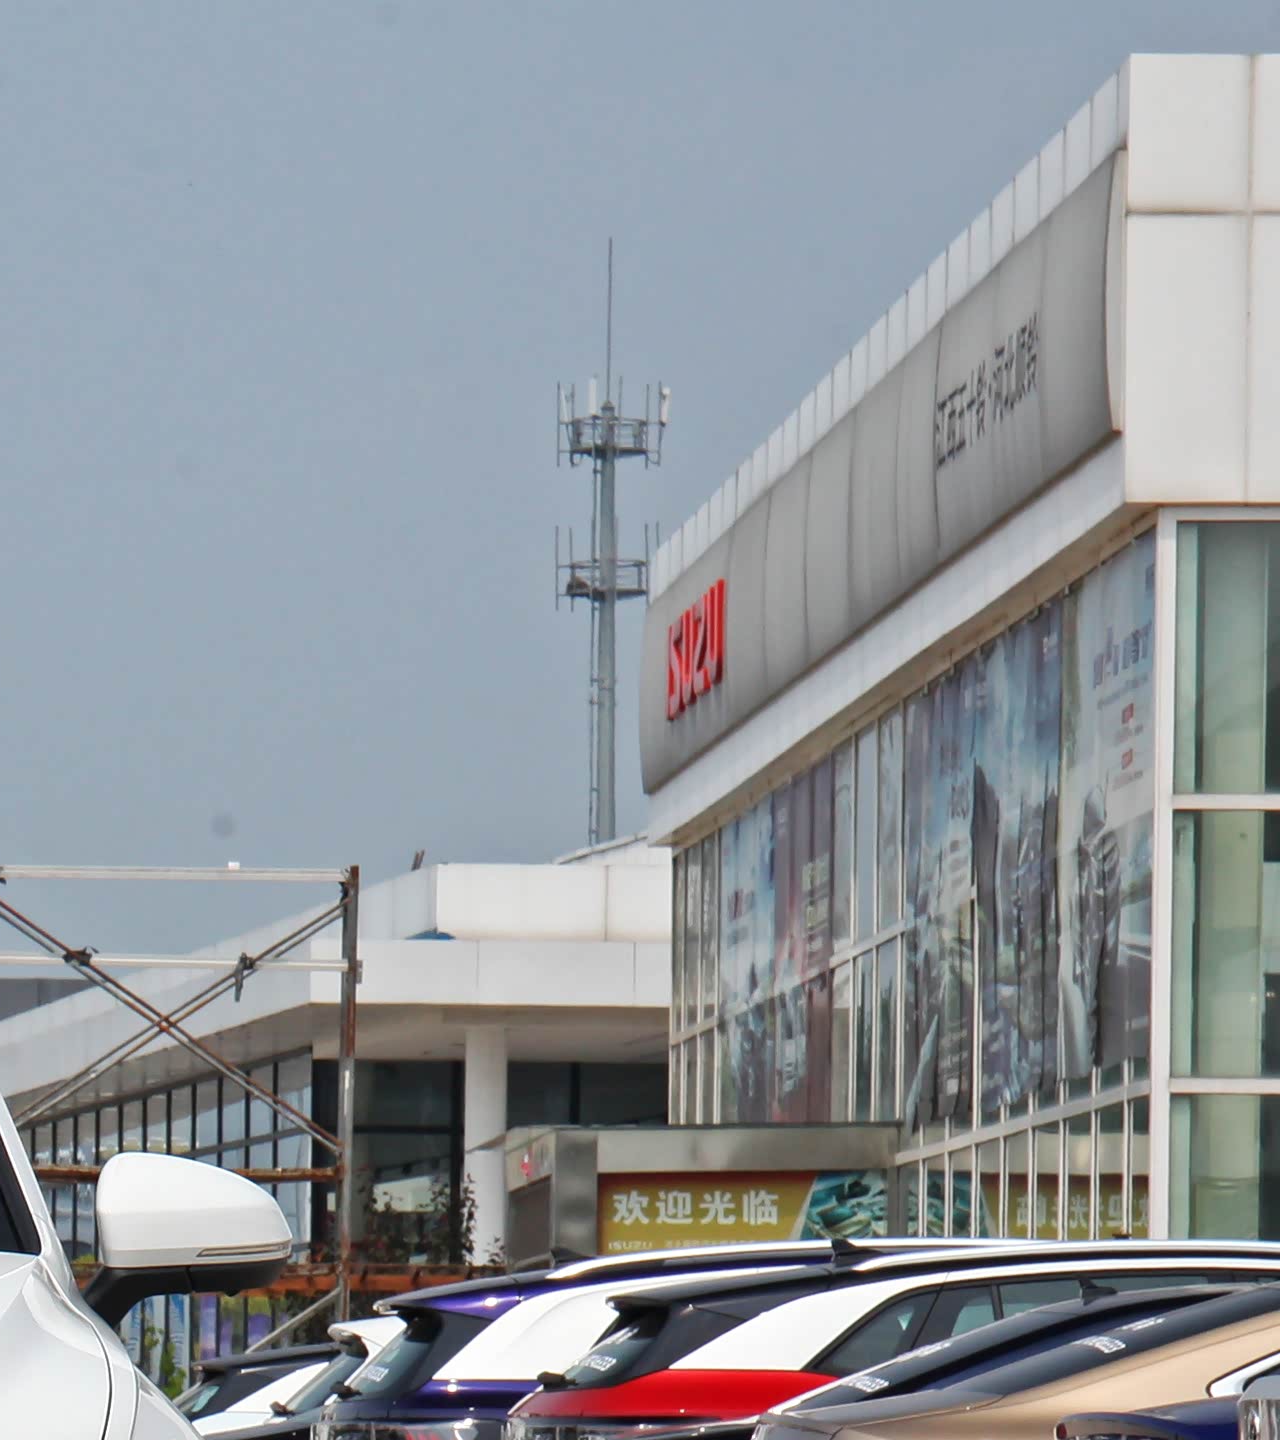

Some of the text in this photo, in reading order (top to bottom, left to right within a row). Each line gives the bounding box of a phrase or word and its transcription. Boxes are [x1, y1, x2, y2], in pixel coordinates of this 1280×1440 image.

[667, 577, 726, 722] ISUZU
[612, 1189, 780, 1226] 欢迎光临
